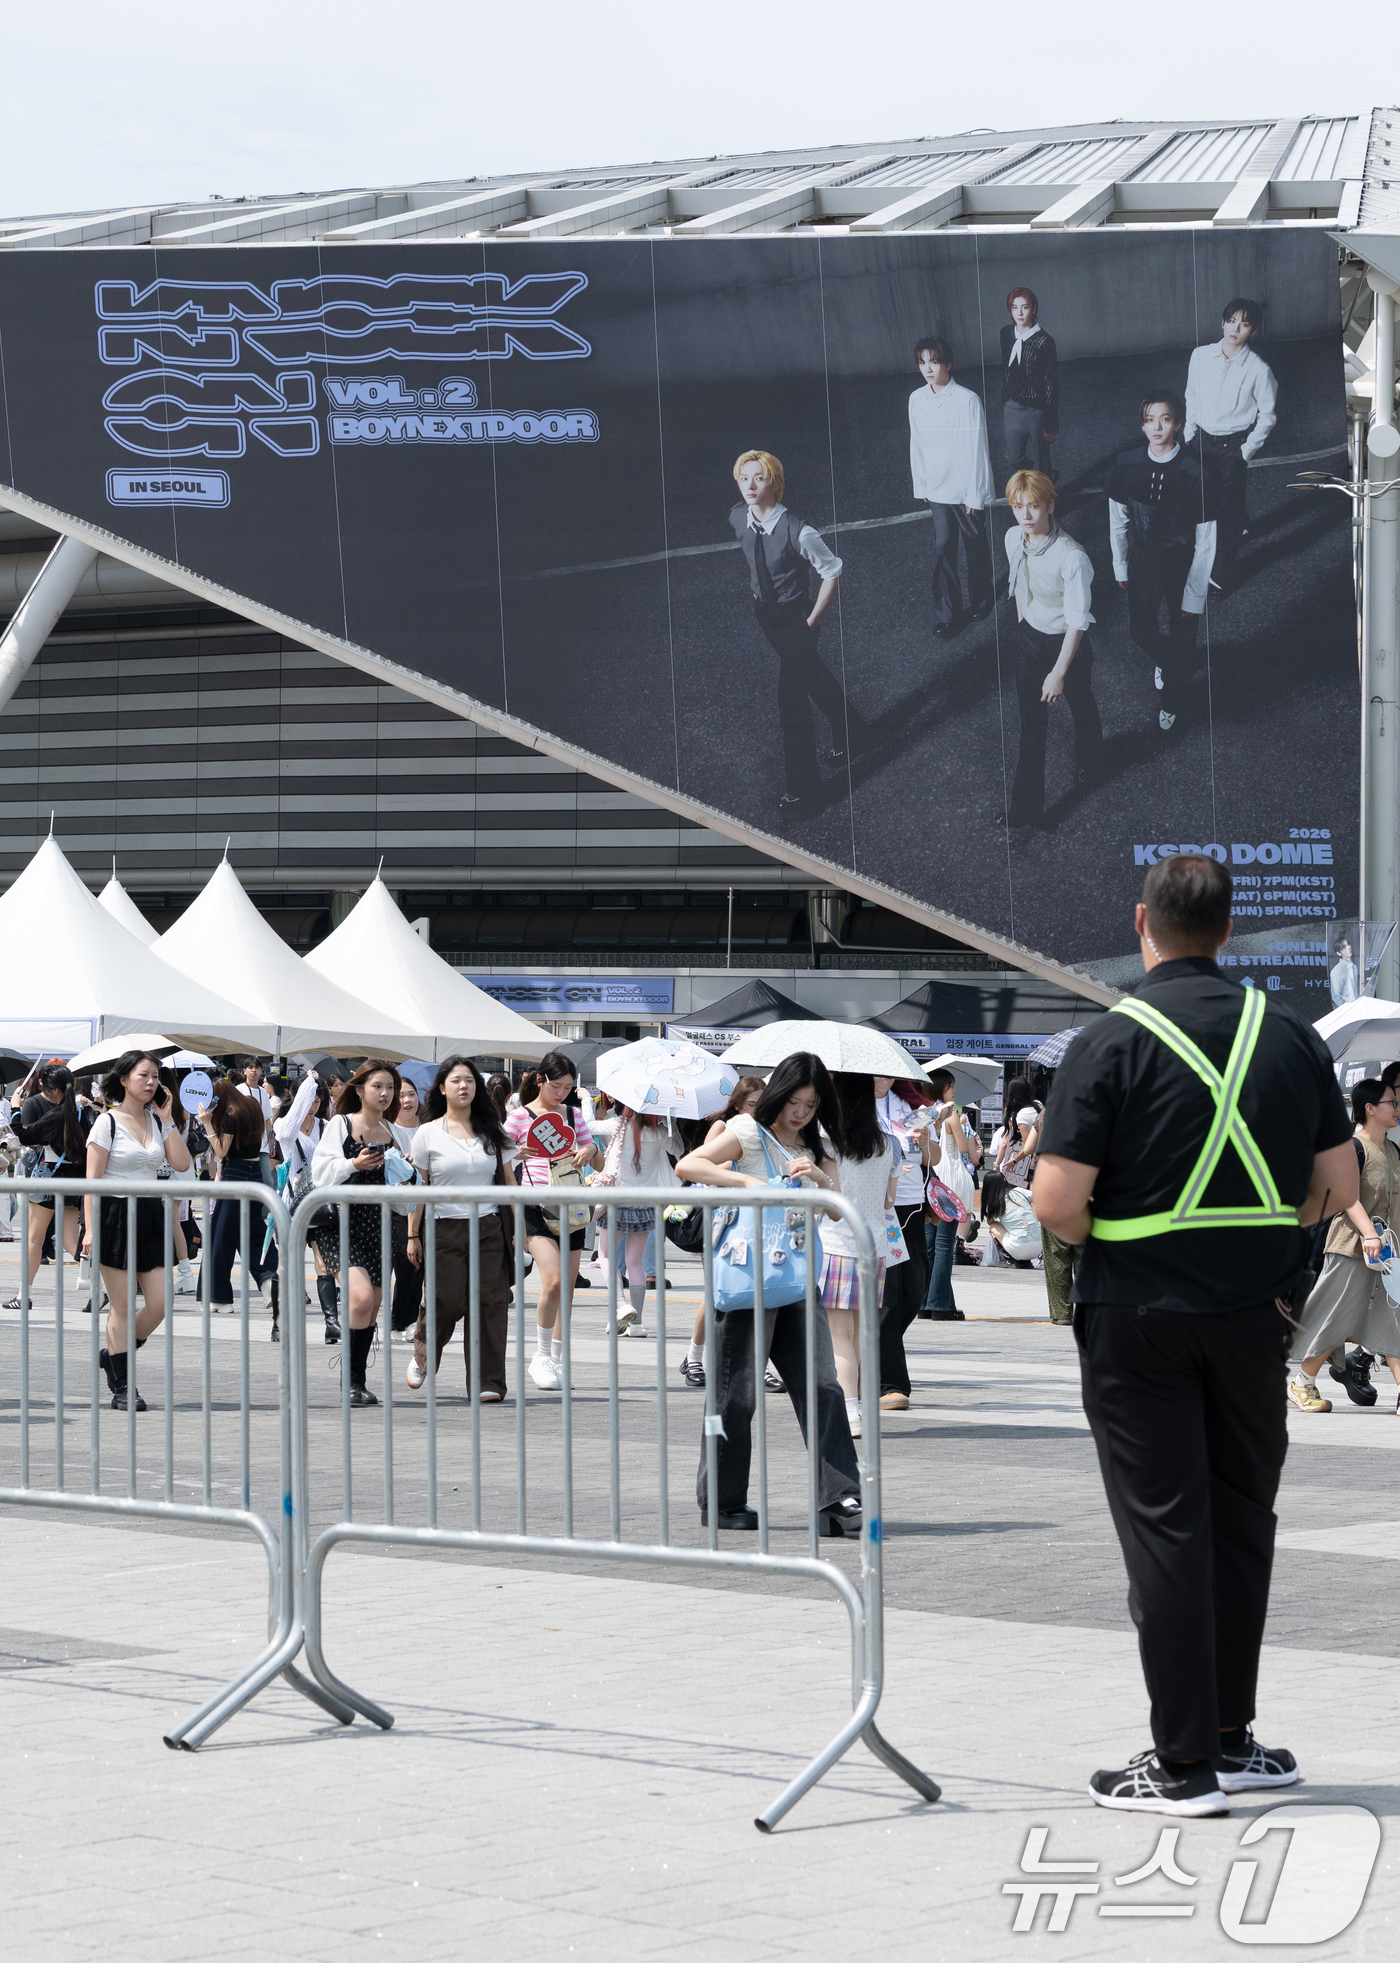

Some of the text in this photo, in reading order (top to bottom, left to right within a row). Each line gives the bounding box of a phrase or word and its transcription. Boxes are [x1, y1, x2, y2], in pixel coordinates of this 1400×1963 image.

[329, 411, 598, 443] BOYNEXTDOOR
[129, 480, 207, 495] IN SEOUL
[1289, 828, 1331, 839] 2026
[1231, 843, 1334, 865] DOME
[1230, 876, 1335, 888] FRI) 7PM(KST)
[1231, 891, 1336, 903] SAT) 6PM(KST)
[1230, 906, 1337, 918] SUN) 5PM(KST)
[1267, 941, 1327, 953] +ONLIN
[1216, 955, 1327, 966] VE STREAMIN
[1304, 980, 1330, 988] HYB
[607, 995, 669, 1003] BOYNEXTDOOR
[714, 1033, 726, 1041] CS
[727, 1033, 741, 1041] 부스
[945, 1039, 964, 1049] 입장
[966, 1039, 993, 1049] 게이트
